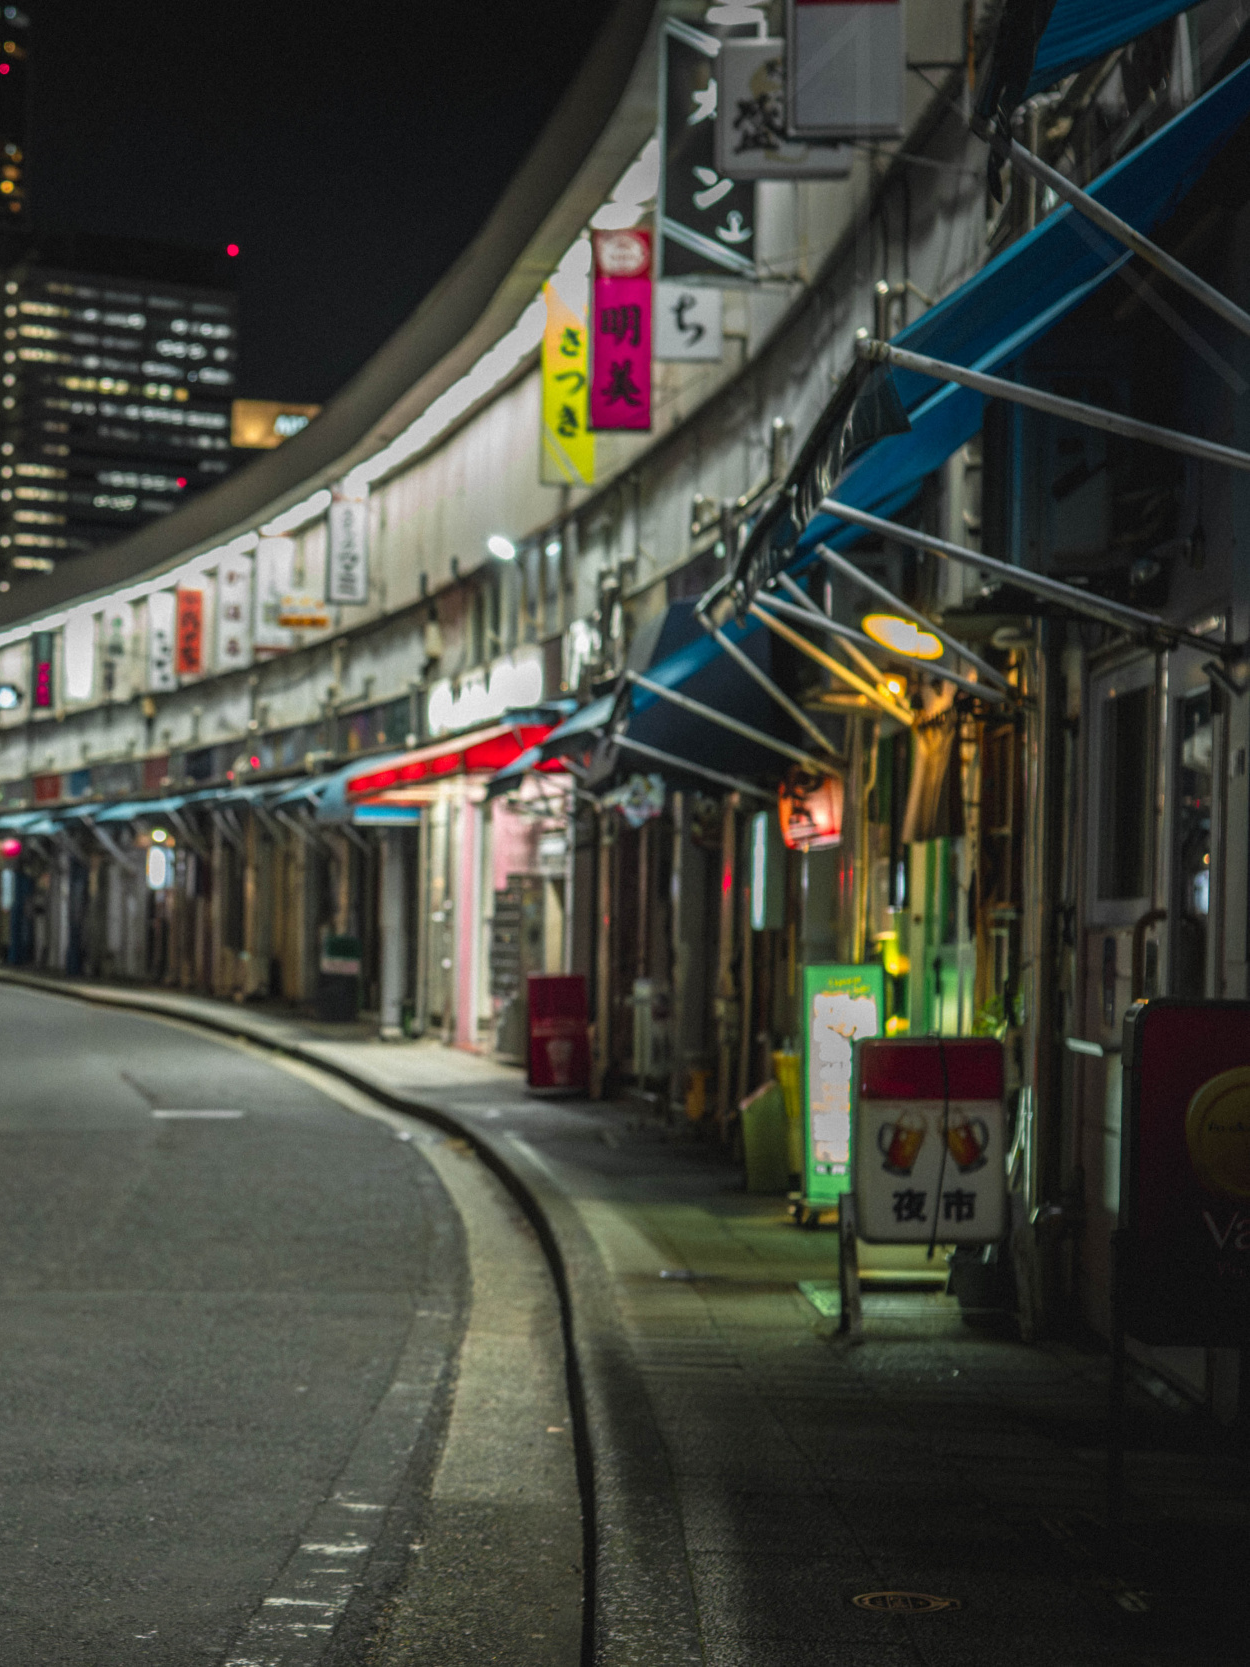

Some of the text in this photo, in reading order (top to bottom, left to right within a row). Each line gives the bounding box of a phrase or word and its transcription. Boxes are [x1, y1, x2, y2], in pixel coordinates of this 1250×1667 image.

[554, 325, 587, 438] さつき
[600, 303, 642, 407] 明美
[892, 1187, 978, 1224] 夜市
